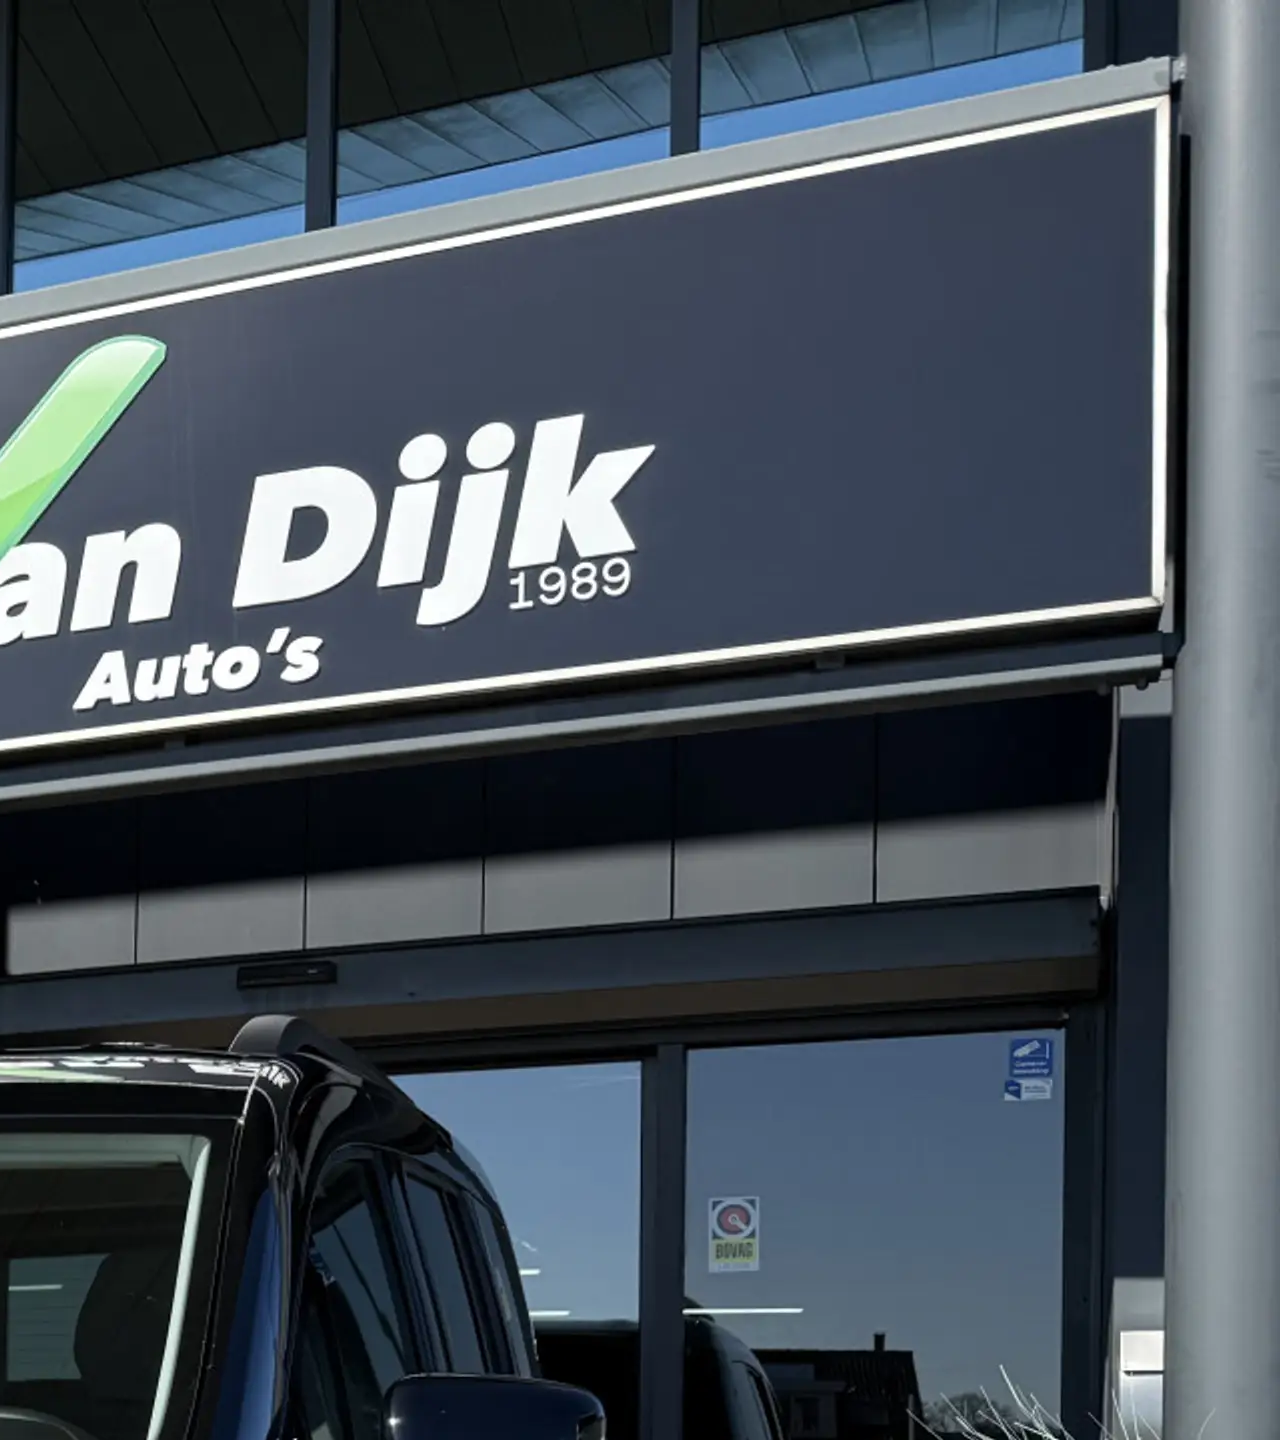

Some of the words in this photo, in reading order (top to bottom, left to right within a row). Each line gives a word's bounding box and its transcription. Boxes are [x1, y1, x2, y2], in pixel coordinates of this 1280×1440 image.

[231, 412, 657, 627] Dijk
[508, 557, 632, 610] 1989
[72, 626, 324, 711] Auto's
